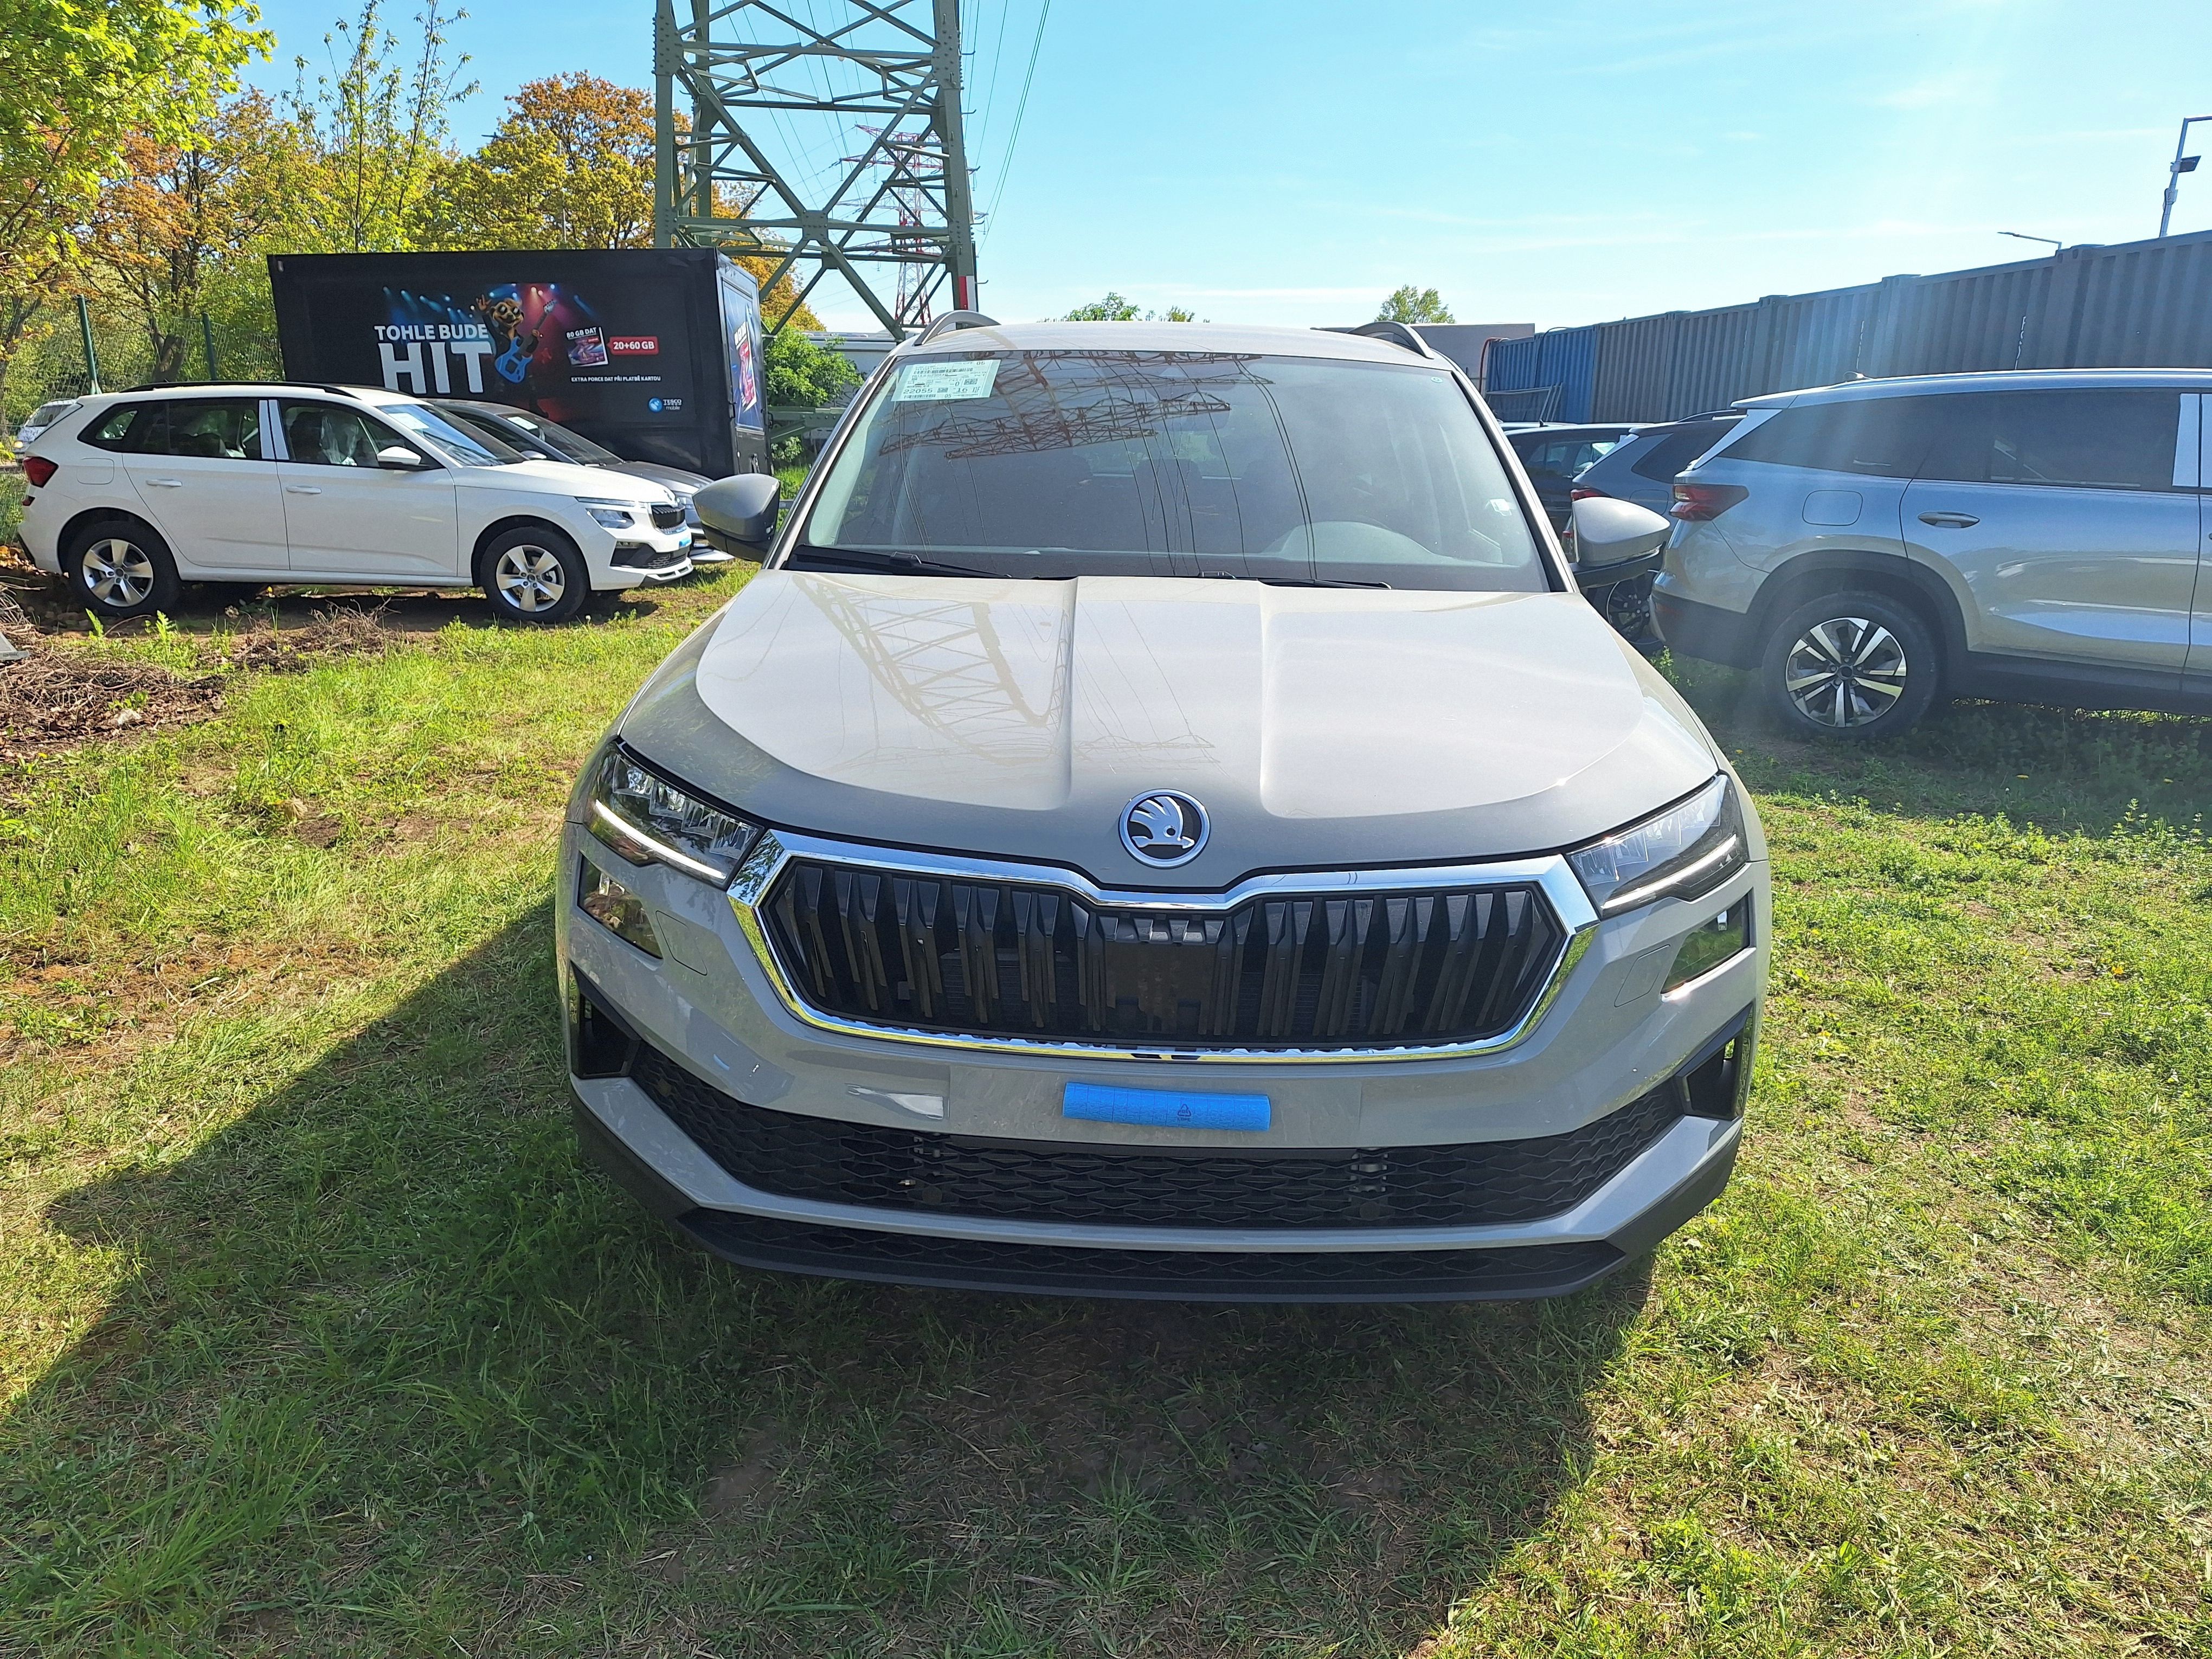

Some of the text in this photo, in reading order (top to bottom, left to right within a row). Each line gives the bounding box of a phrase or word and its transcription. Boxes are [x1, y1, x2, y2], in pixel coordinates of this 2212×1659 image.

[374, 323, 489, 340] TOHLE BUDE
[585, 327, 597, 335] DAT
[613, 341, 655, 350] 20+60 GB
[378, 340, 493, 394] HIT
